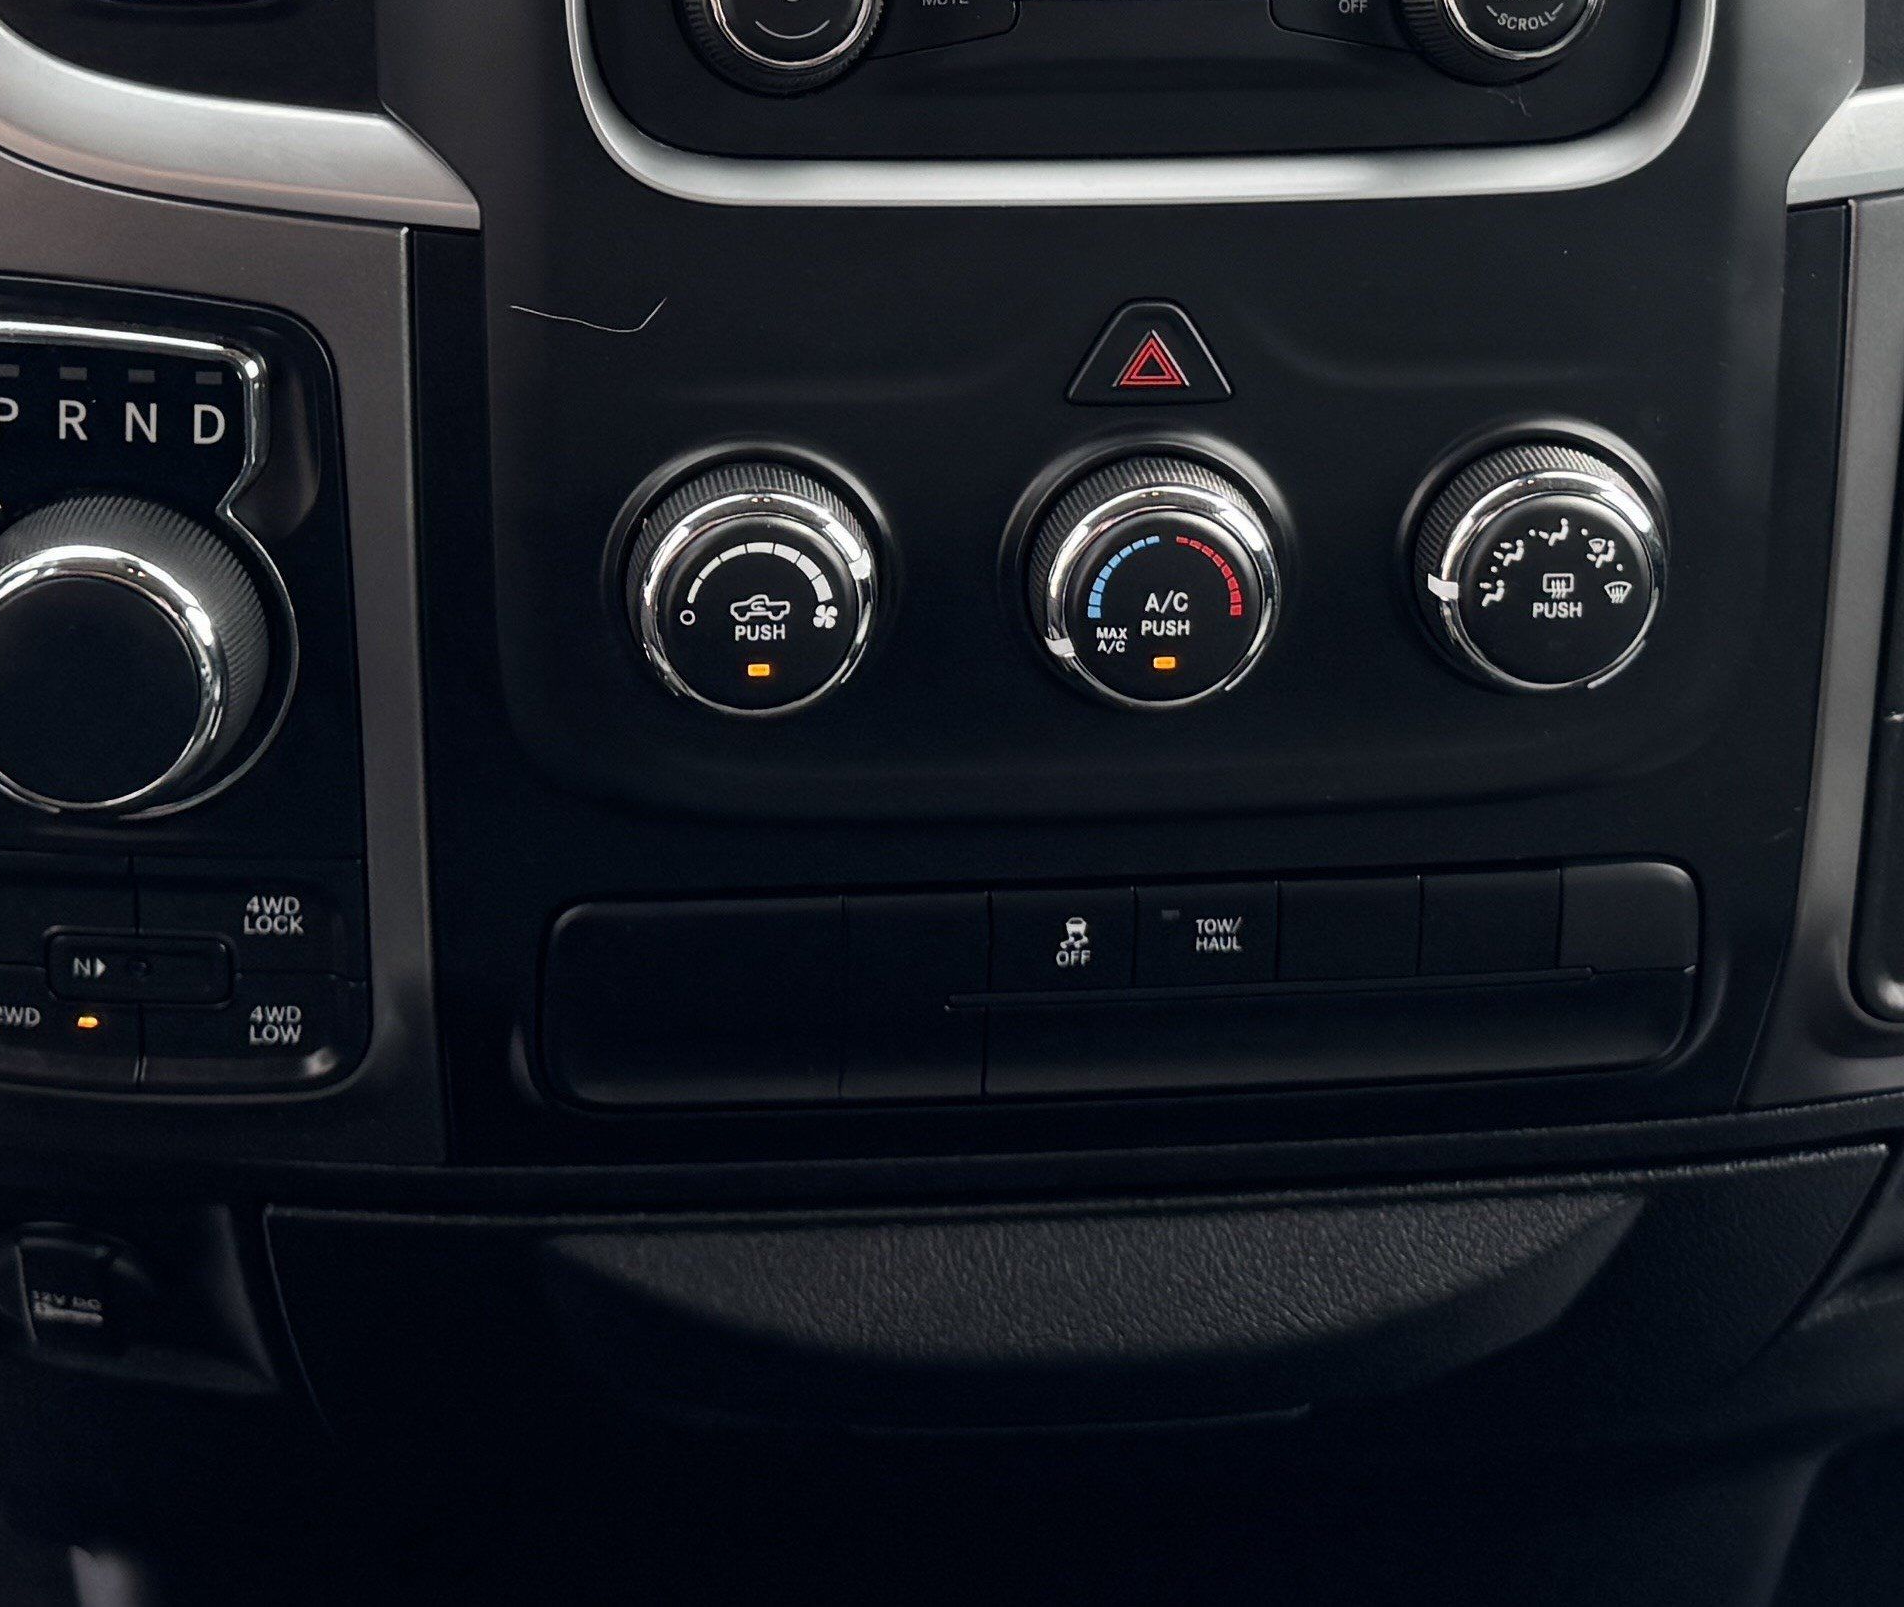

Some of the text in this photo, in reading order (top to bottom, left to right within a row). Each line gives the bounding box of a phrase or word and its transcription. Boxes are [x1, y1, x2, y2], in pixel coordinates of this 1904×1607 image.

[1497, 12, 1557, 32] SCROLL
[59, 399, 88, 441] R
[125, 401, 157, 444] N
[193, 403, 226, 445] D
[1144, 589, 1189, 614] A/C
[1532, 601, 1583, 619] PUSH
[734, 623, 786, 642] PUSH
[1096, 626, 1128, 640] MAX
[1141, 619, 1191, 636] PUSH
[1097, 640, 1126, 655] A/C
[246, 895, 300, 914] 4WD
[243, 915, 305, 936] LOCK
[1195, 916, 1243, 936] TOW/
[1196, 935, 1244, 952] HAUL
[72, 957, 91, 978] N
[1055, 949, 1091, 968] OFF
[248, 1005, 302, 1024] 4WD
[249, 1024, 302, 1045] LOW
